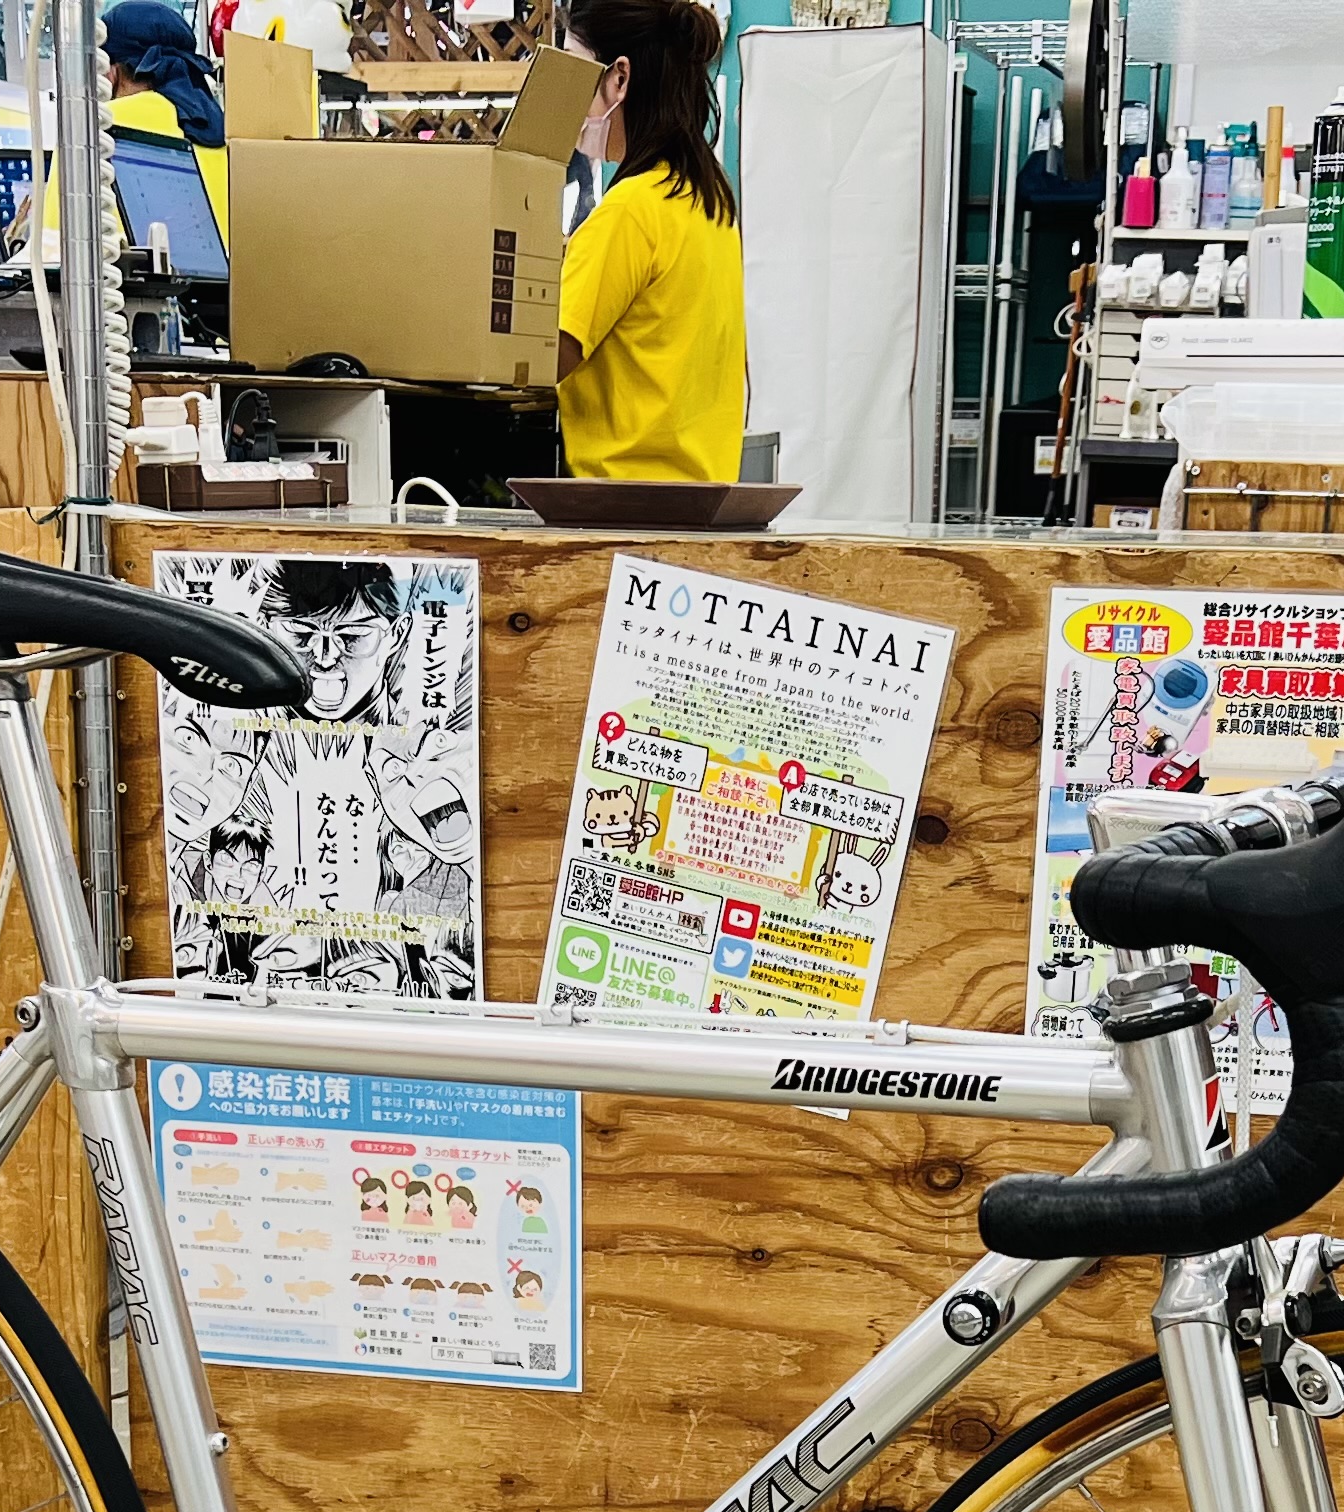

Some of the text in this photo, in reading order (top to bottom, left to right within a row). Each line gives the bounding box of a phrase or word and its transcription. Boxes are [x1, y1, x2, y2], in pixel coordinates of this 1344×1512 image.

[1096, 605, 1161, 622] リサイクル
[1086, 625, 1169, 653] 愛品館
[420, 600, 449, 709] 電子レンジは
[170, 655, 244, 694] Flite
[616, 641, 631, 656] It
[634, 643, 648, 659] is
[653, 652, 661, 663] a
[667, 655, 728, 679] message
[735, 670, 768, 688] from
[773, 679, 815, 699] Japan
[821, 691, 834, 703] to
[842, 696, 864, 710] the
[628, 737, 683, 763] どんな物を
[605, 750, 697, 785] 買取ってくれるの?
[706, 783, 776, 809] ご相談下さい
[721, 771, 768, 793] お気軽に
[799, 783, 892, 815] お店で売っている物は
[789, 798, 890, 833] 全部買取したものだよ!
[316, 792, 341, 913] なんだって
[618, 877, 684, 905] 愛品館HP
[571, 946, 596, 961] LINE
[610, 952, 676, 984] LINE@
[607, 974, 695, 1009] 友だち募集中。
[208, 1073, 352, 1105] 感染症対策
[371, 1081, 566, 1104] 新型コロナウイルスを含む感染症対策の
[770, 1058, 1003, 1102] BRIDGESTONE
[208, 1102, 352, 1121] へのご協力をお願いします
[371, 1095, 567, 1119] 基本は、「手洗い」や「マスクの着用を含む
[371, 1111, 466, 1128] 咳エチケット」です。
[247, 1134, 326, 1149] 正しい手の洗い方
[424, 1146, 512, 1163] 3つの咳エチケット
[83, 1133, 158, 1345] RADAC
[350, 1249, 439, 1268] 正しいマスクの着用
